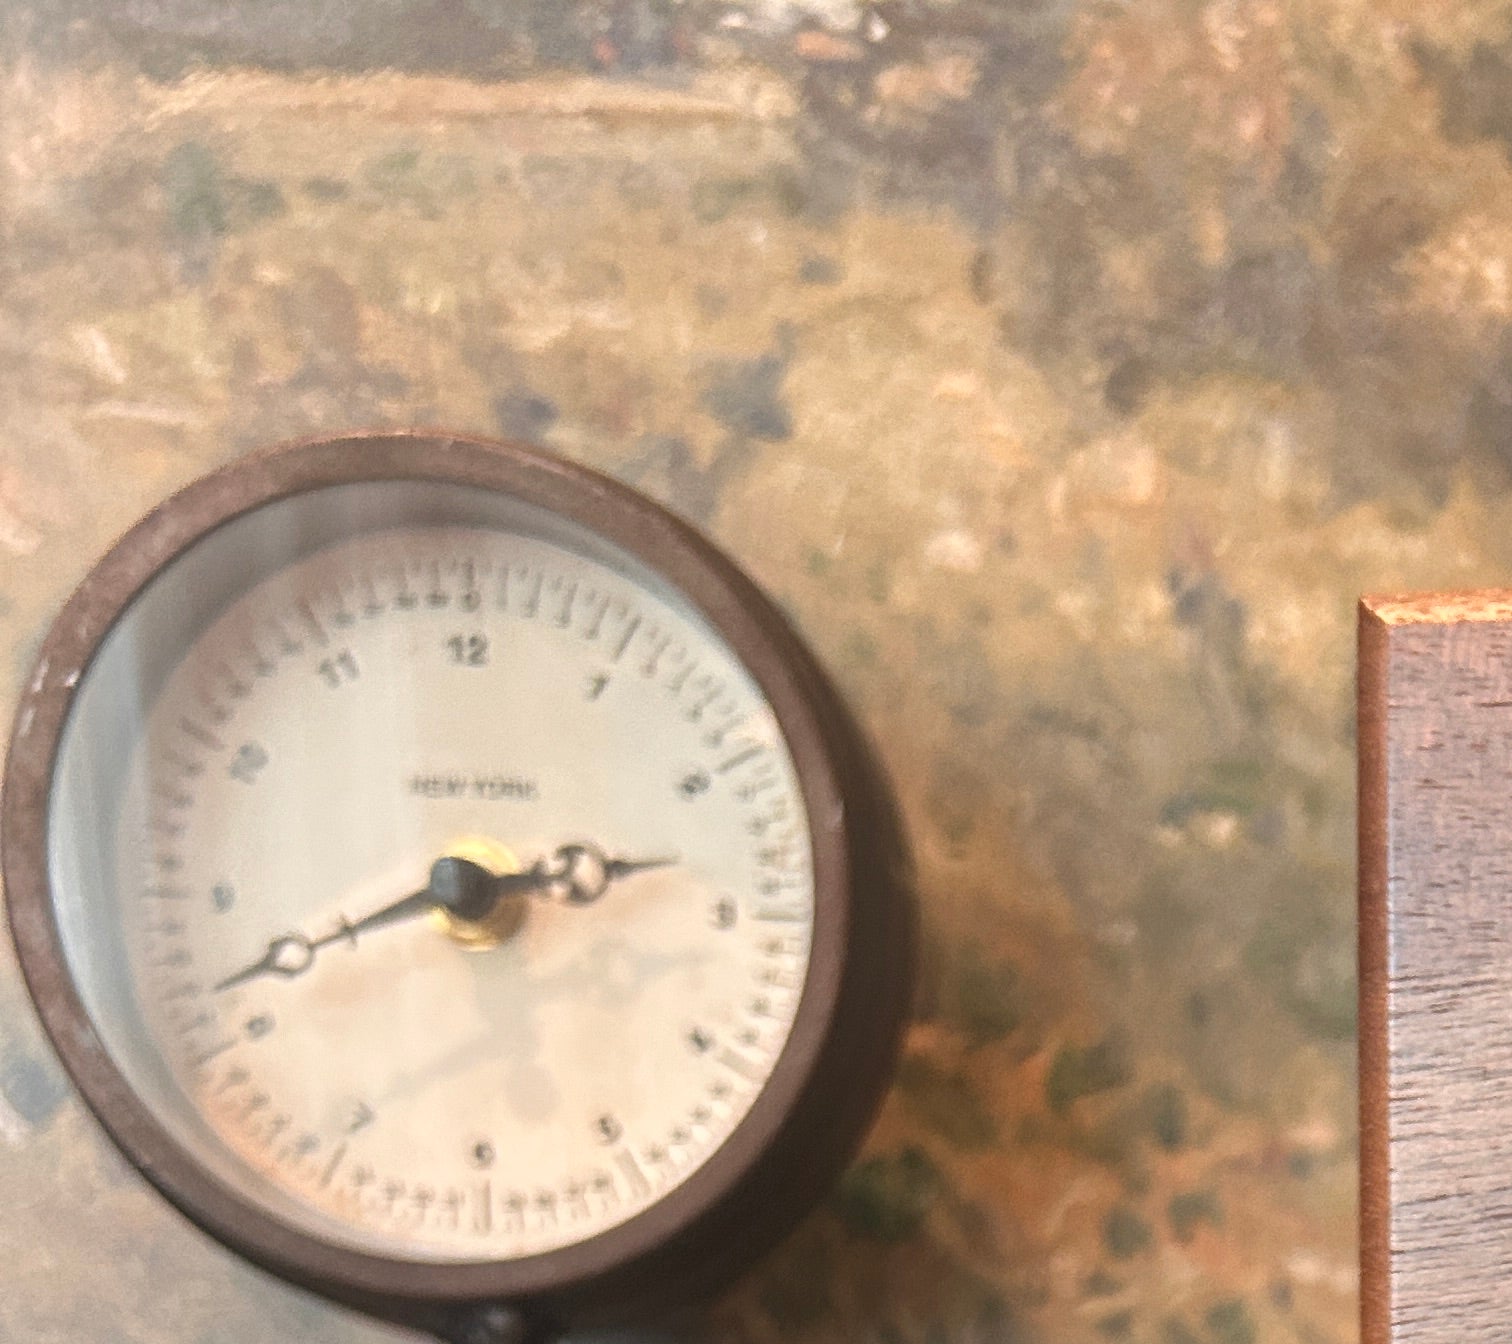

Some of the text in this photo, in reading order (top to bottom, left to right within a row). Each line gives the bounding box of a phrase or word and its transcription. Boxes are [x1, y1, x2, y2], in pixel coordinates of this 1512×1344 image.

[446, 632, 489, 668] 12
[410, 775, 539, 799] NEW YORK
